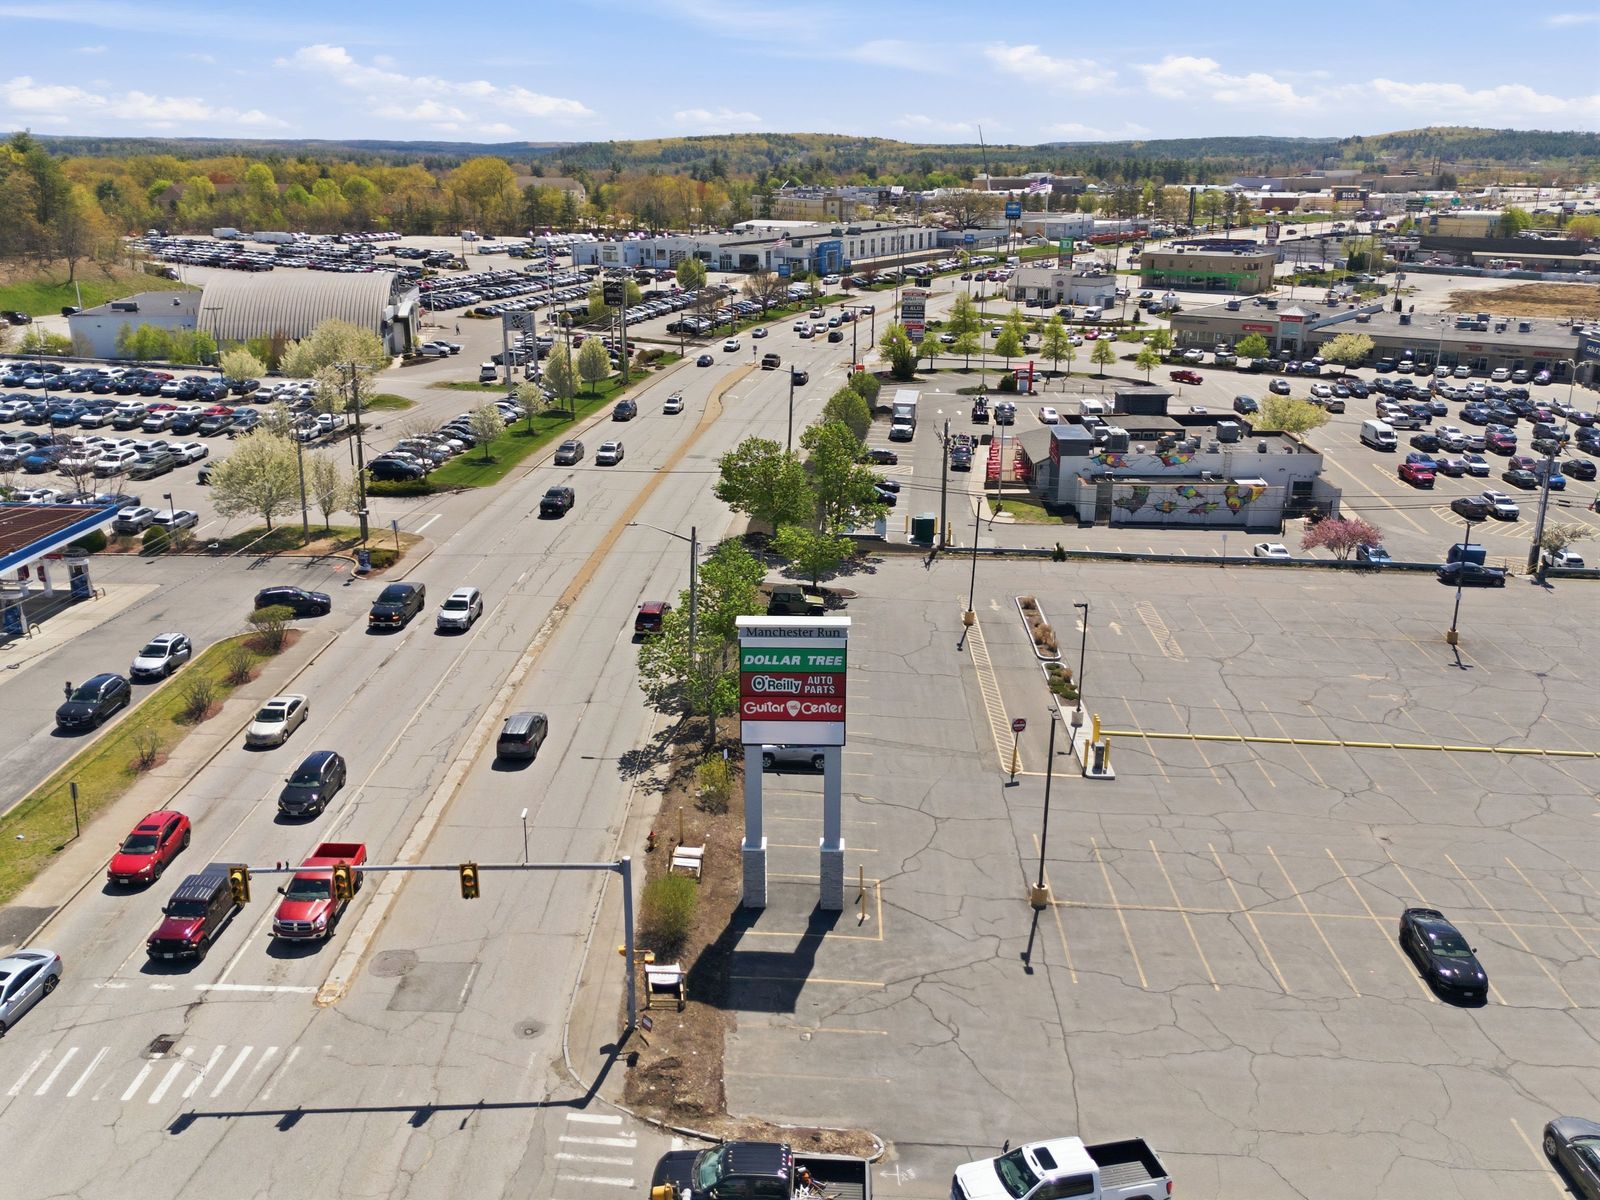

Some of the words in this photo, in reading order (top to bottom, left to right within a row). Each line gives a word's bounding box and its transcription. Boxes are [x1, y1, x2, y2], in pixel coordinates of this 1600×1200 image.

[746, 627, 813, 637] Manchester
[817, 628, 840, 637] Run
[744, 655, 801, 665] DOLLAR
[807, 655, 843, 665] TREE
[752, 675, 802, 694] O'Reilly
[808, 676, 833, 685] AUTO
[804, 685, 835, 694] PARTS
[744, 701, 785, 714] Guitar
[801, 702, 843, 715] Center
